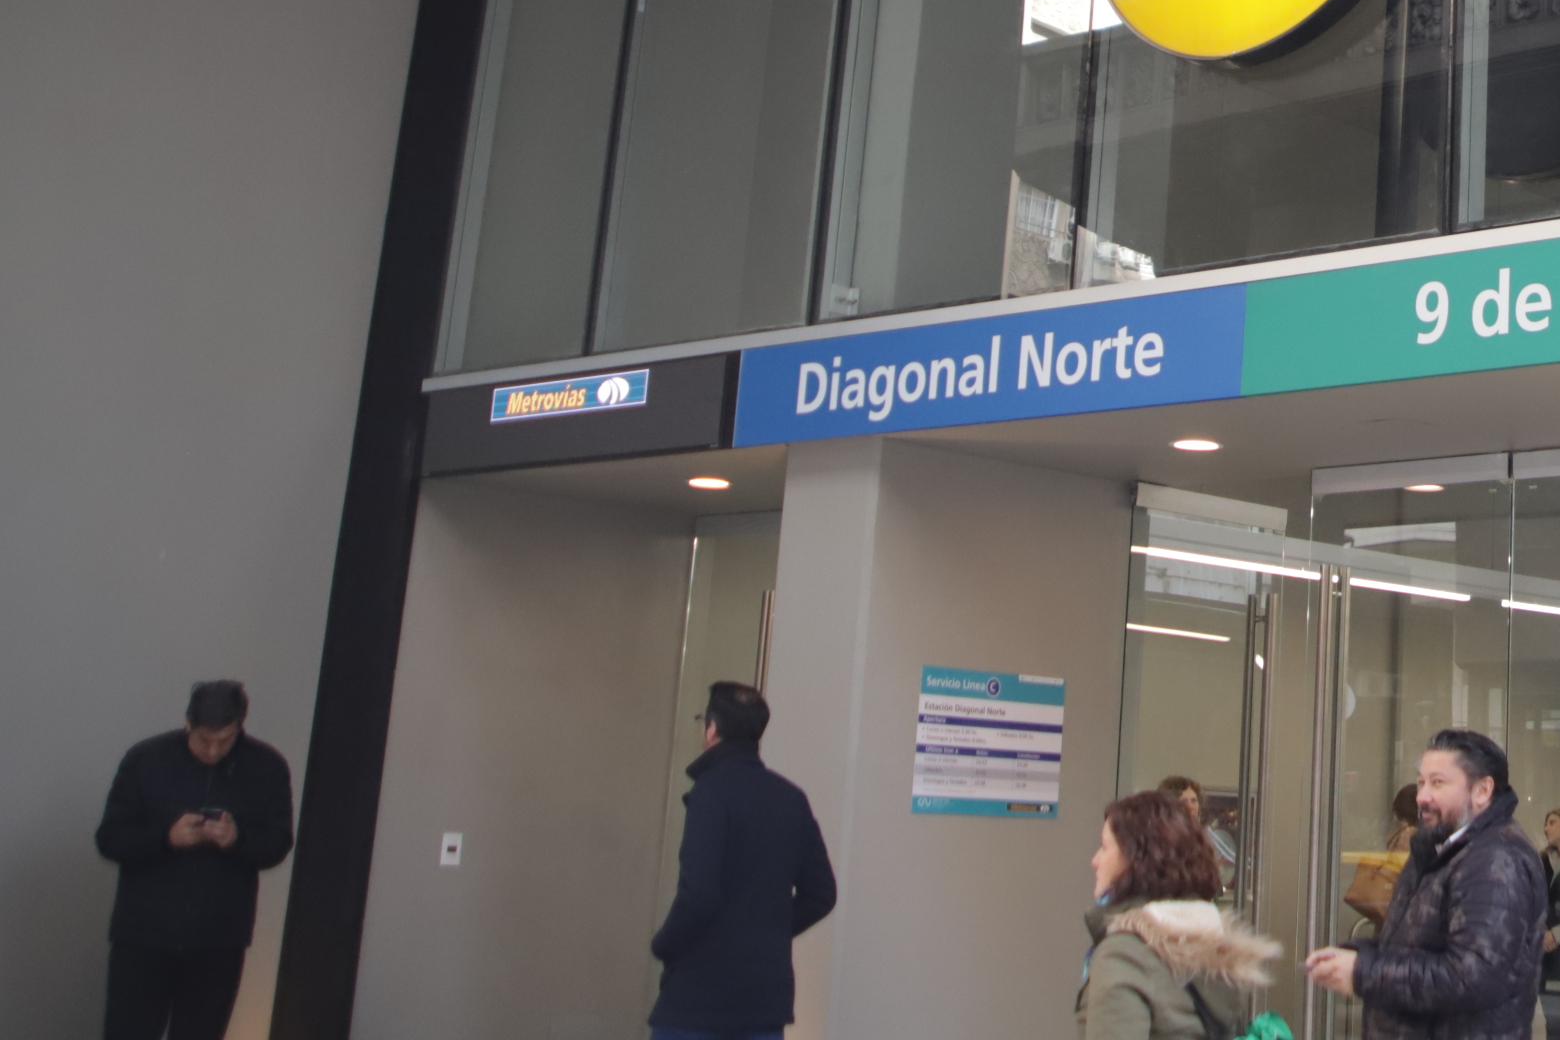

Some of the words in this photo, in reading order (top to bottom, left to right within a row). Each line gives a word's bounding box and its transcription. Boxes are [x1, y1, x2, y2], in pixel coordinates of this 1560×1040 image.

[1415, 281, 1449, 346] 9
[1471, 267, 1552, 338] de
[796, 335, 1001, 422] Diagonal
[1016, 326, 1164, 390] Norte
[505, 384, 587, 415] Metrovías
[926, 675, 961, 690] Servicio
[924, 701, 954, 712] Estación
[954, 704, 985, 716] Diagonal
[987, 707, 1006, 716] Norte
